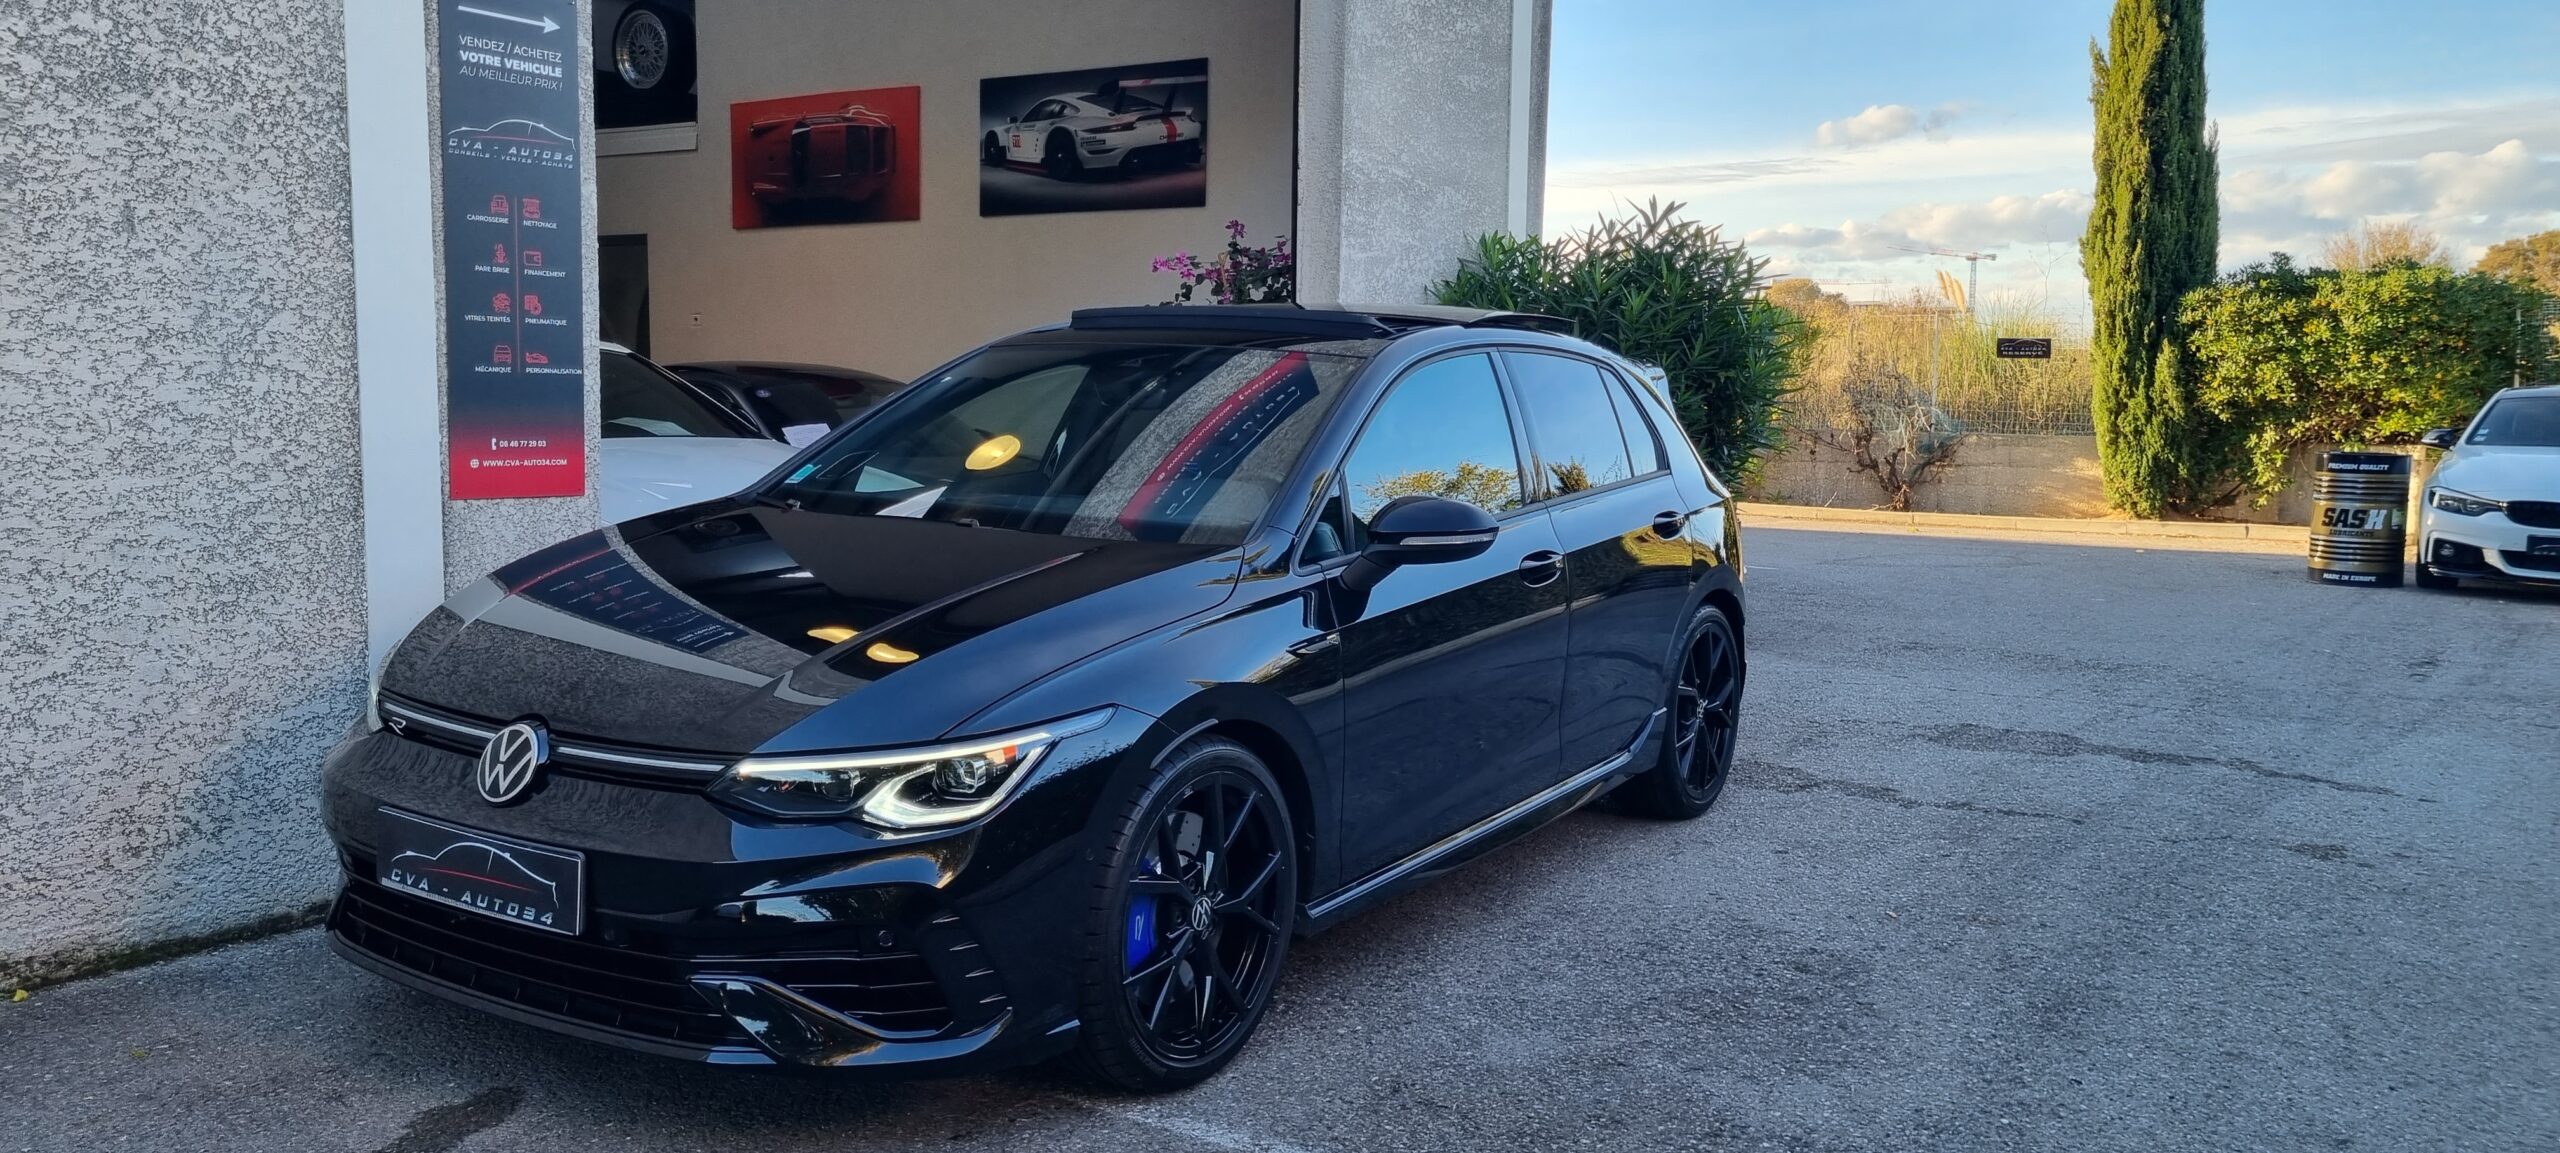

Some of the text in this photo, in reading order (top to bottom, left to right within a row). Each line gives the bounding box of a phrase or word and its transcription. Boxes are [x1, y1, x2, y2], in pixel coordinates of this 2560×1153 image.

[459, 35, 505, 53] VENDEZ
[514, 45, 562, 63] ACHETEZ
[459, 50, 562, 78] VOTRE VEHICULE
[459, 65, 476, 77] AU
[478, 68, 532, 86] MEILLEUR
[535, 78, 557, 90] PRIX
[449, 138, 482, 150] CVA
[508, 146, 573, 162] AUTO34
[448, 148, 490, 158] CONSEILS
[501, 155, 532, 164] VENTES
[541, 161, 573, 169] ACHATS
[467, 214, 509, 224] CARROSSERIE
[523, 220, 558, 229] NETTOYAGE
[475, 265, 510, 274] PARE BRISE
[524, 269, 566, 278] FINANCEMENT
[465, 314, 486, 322] VITRES
[525, 317, 568, 326] PNEUMATIQUE
[526, 367, 582, 375] PERSONNALISATION
[519, 440, 528, 448] 77
[538, 440, 546, 448] 03
[482, 458, 568, 468] WWW.CVA-AUTO34.COM
[2321, 507, 2387, 530] SASH
[391, 869, 429, 891] CVA
[461, 890, 554, 925] AUTO34
